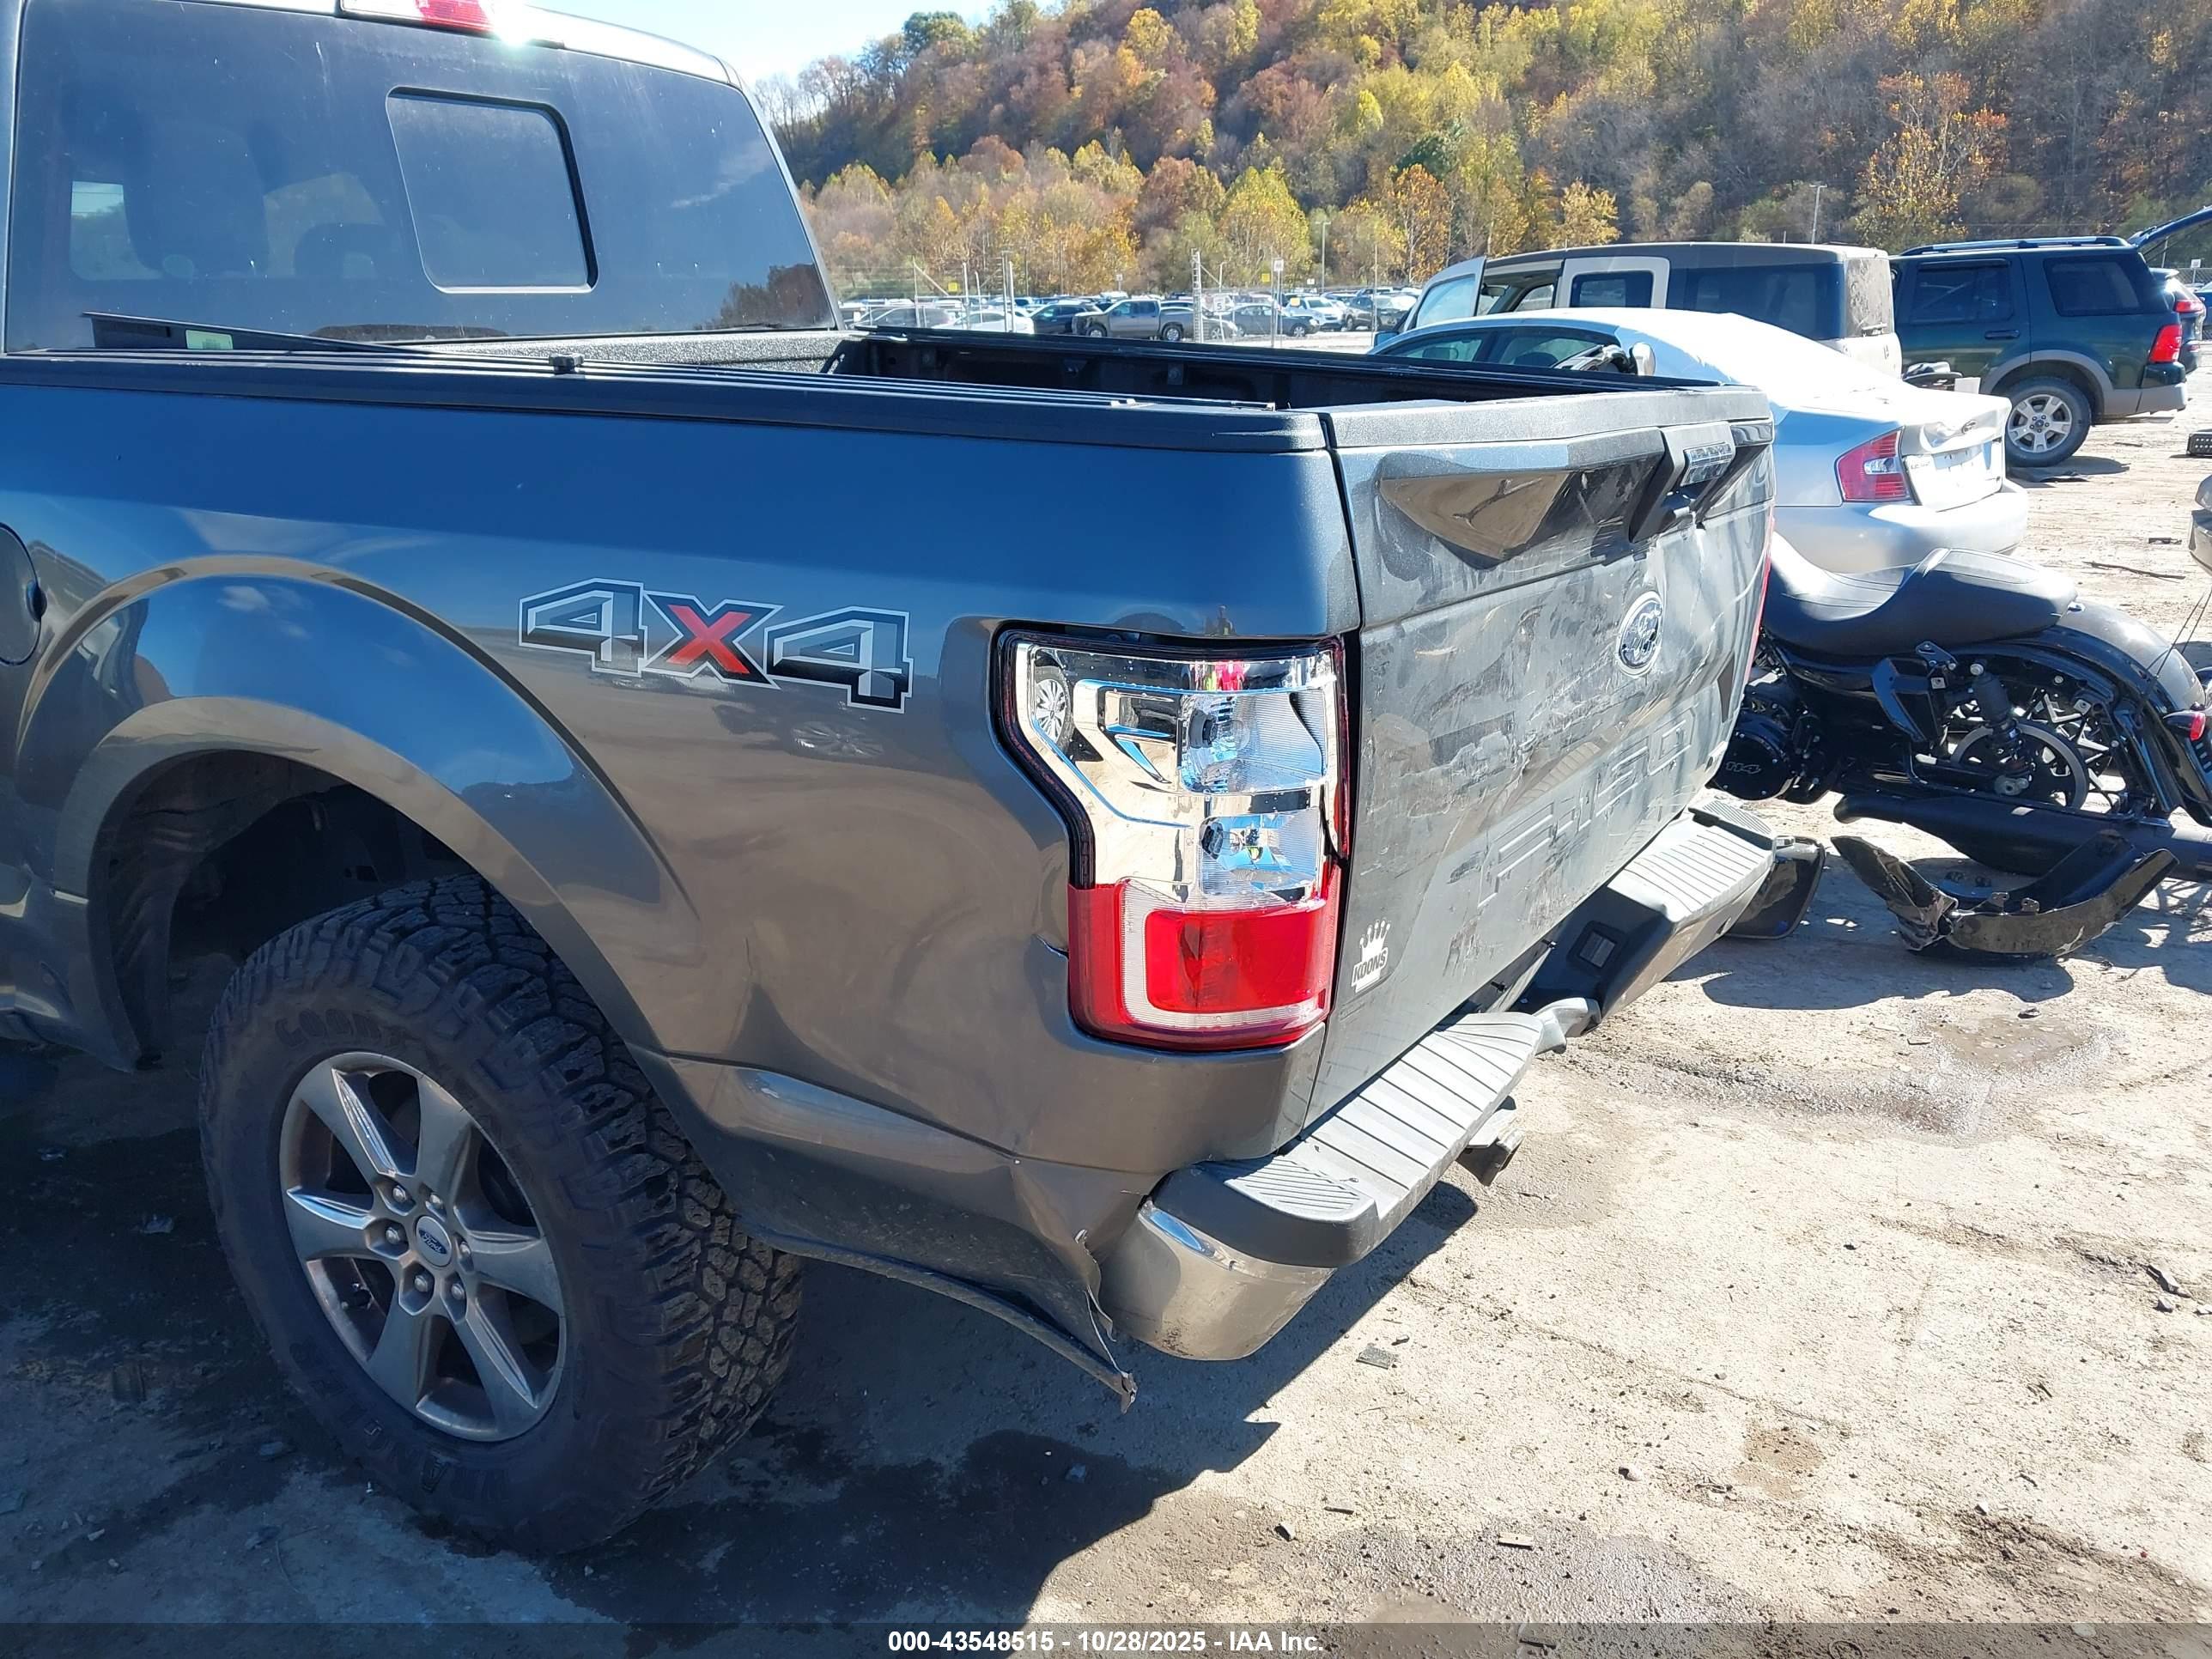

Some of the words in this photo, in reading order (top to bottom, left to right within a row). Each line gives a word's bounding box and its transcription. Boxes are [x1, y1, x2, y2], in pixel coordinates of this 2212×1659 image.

[1725, 761, 1762, 775] 114
[1476, 706, 1697, 908] F-150
[1352, 949, 1388, 982] KOONS
